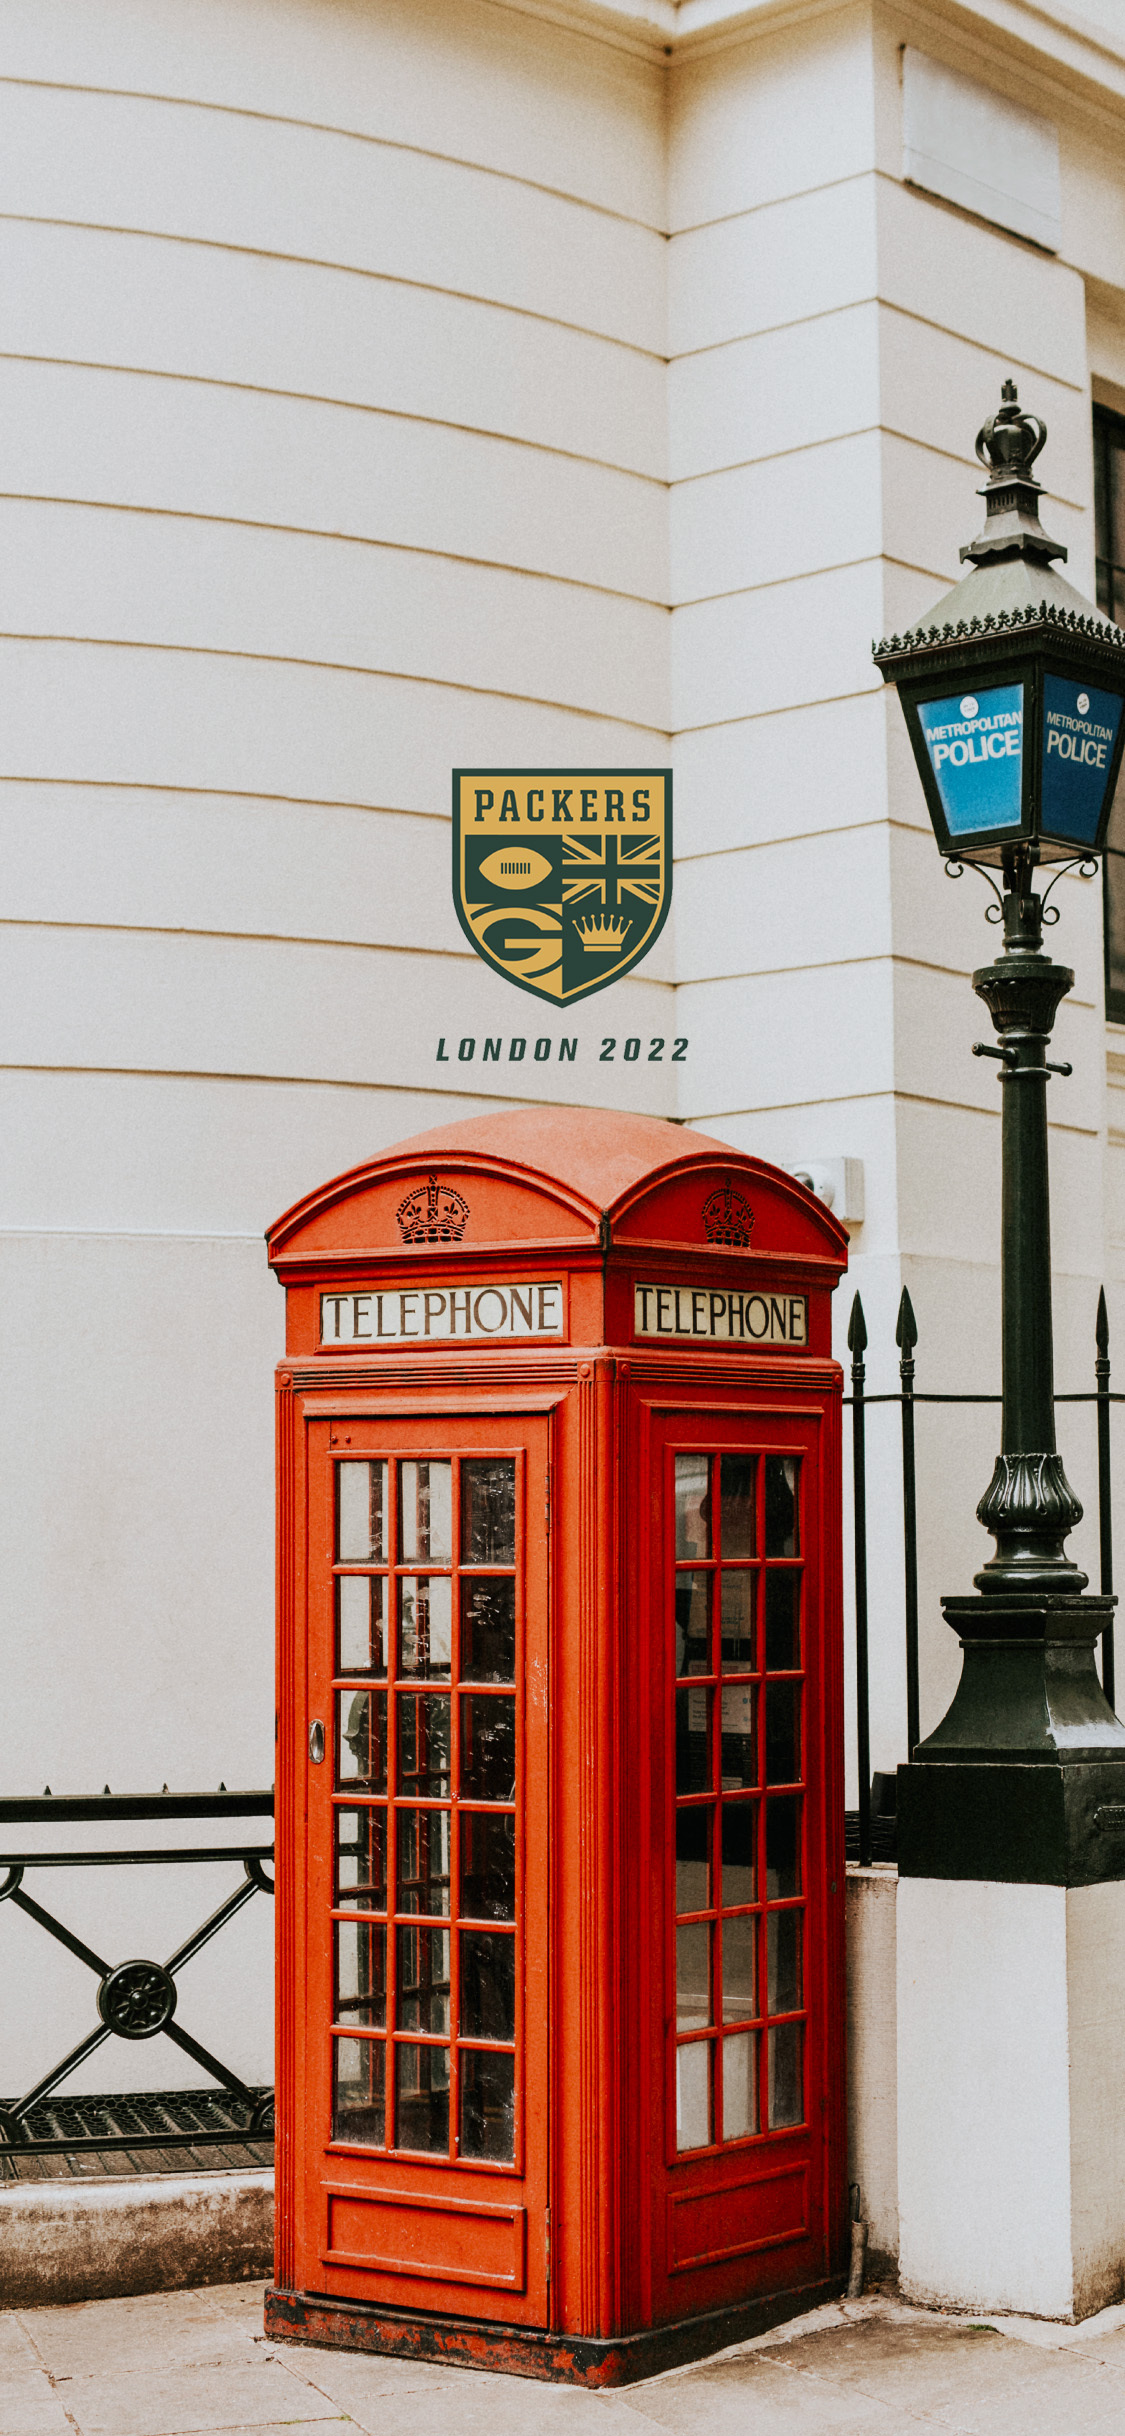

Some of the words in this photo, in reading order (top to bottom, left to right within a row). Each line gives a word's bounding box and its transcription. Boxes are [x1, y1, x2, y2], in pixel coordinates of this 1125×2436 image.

[926, 711, 1022, 741] METROPOLITAN
[1047, 711, 1112, 741] METROPOLITAN
[933, 730, 1021, 769] POLICE
[1046, 730, 1107, 768] POLICE
[326, 1286, 559, 1339] TELEPHONE
[635, 1286, 805, 1341] TELEPHONE
